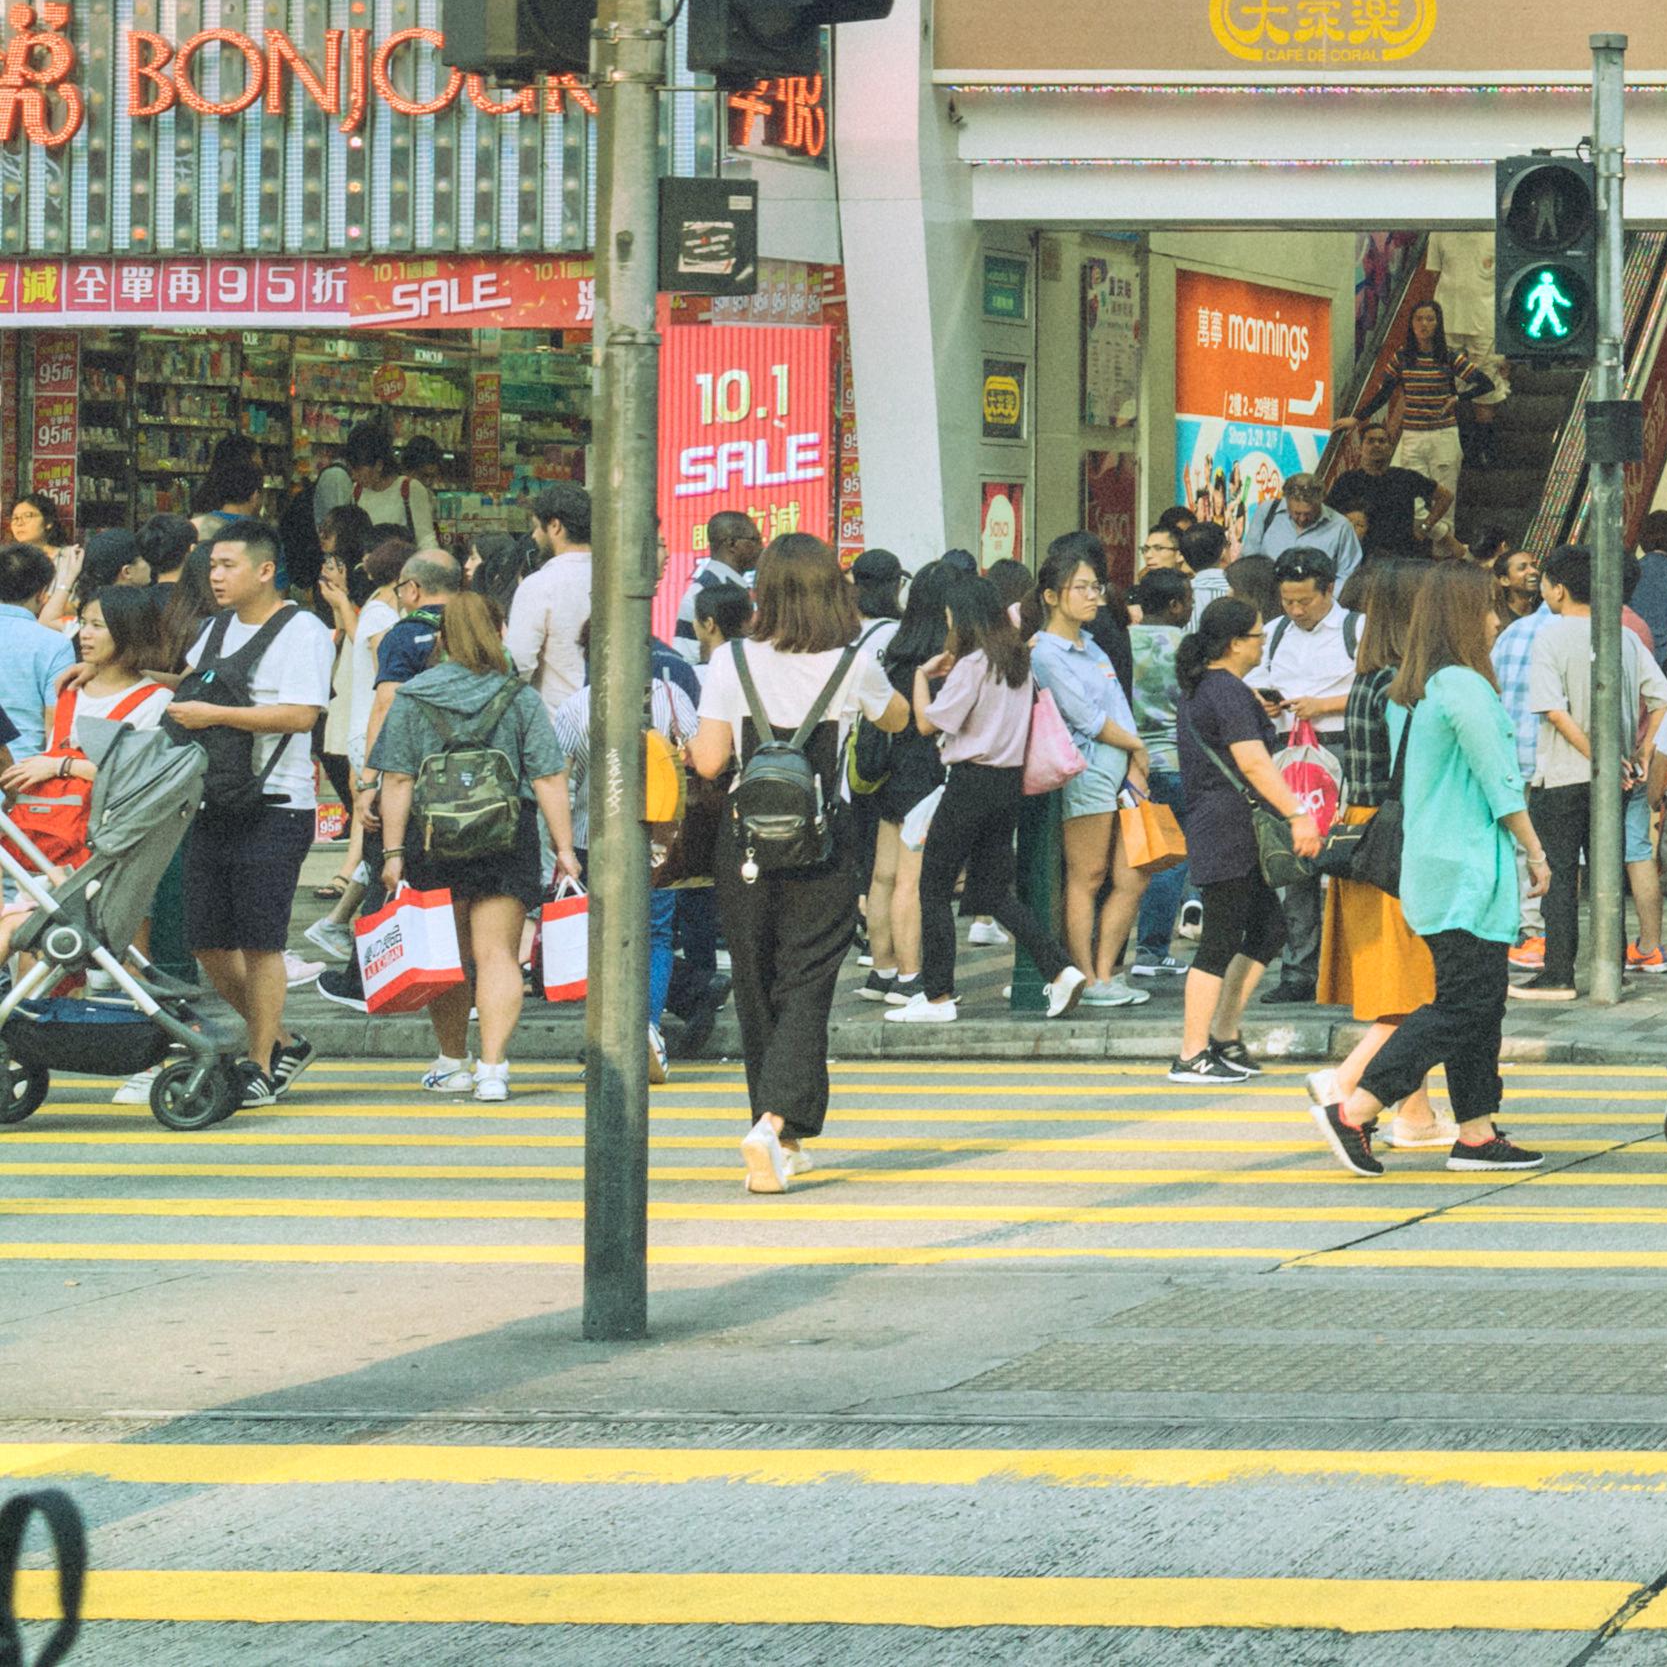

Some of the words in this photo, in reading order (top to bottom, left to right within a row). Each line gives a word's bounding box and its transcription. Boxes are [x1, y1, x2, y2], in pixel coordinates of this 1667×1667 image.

[1329, 48, 1379, 62] CORAL
[372, 273, 512, 319] SALE
[1228, 310, 1310, 372] mannings
[695, 363, 790, 426] 10.1
[674, 433, 825, 498] SALE
